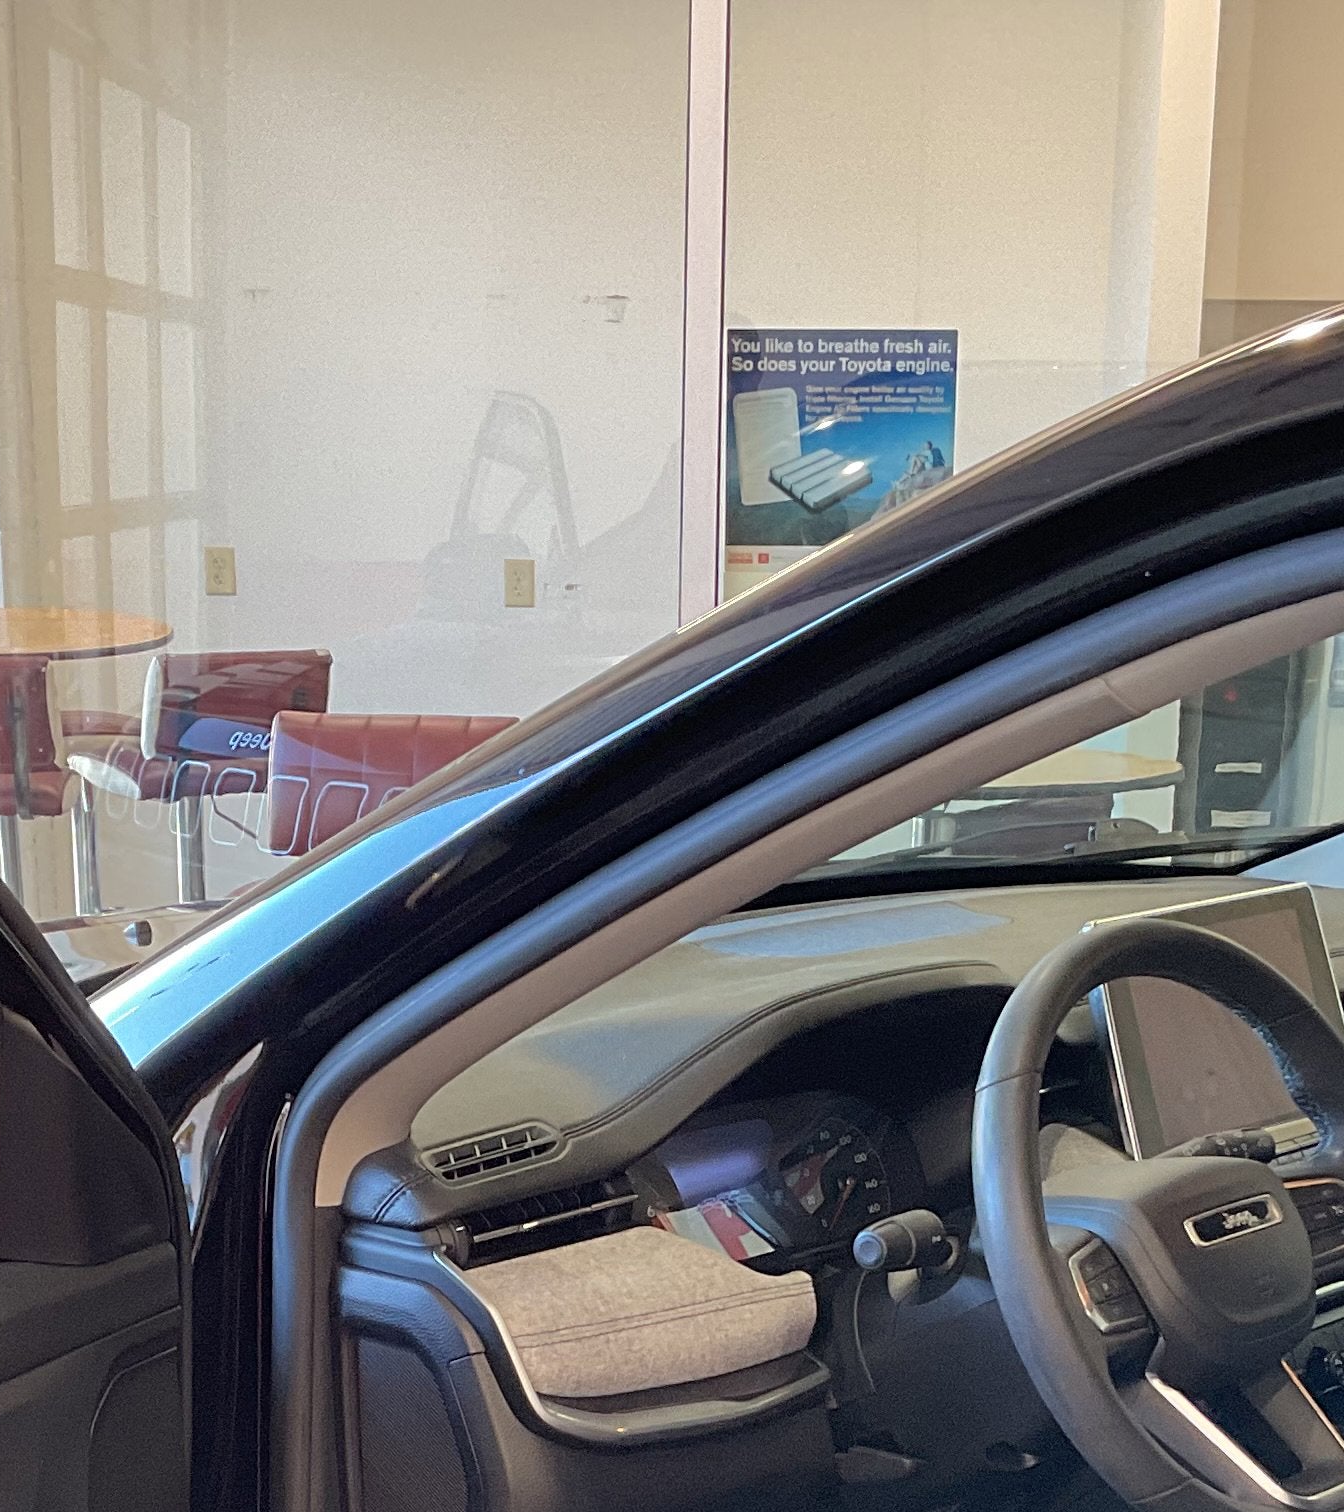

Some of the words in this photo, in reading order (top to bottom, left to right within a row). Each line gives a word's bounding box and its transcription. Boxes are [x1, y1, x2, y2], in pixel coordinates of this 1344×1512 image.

[731, 338, 760, 354] You
[765, 338, 794, 354] like
[798, 339, 814, 354] to
[818, 338, 880, 354] breathe
[883, 338, 923, 354] fresh
[928, 339, 952, 354] air.
[731, 356, 754, 372] So
[757, 356, 797, 372] does
[800, 360, 836, 375] your
[839, 357, 892, 375] Toyota
[895, 357, 954, 375] engine.
